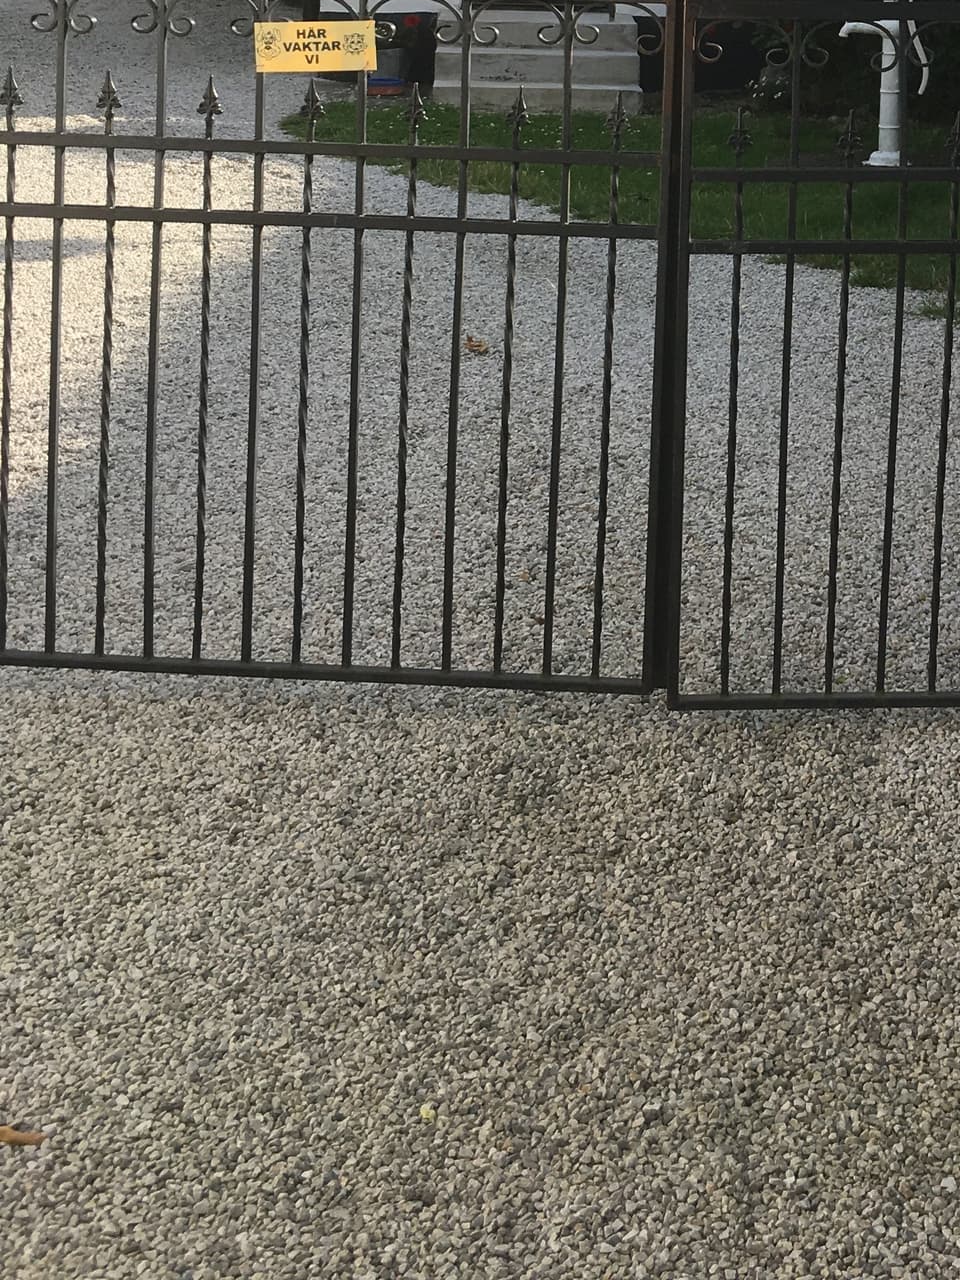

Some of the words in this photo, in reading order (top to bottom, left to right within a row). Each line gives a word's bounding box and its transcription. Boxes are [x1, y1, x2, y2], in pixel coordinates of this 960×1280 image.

[296, 27, 327, 39] HÄR
[283, 41, 341, 52] VAKTAR
[305, 54, 319, 64] VI
